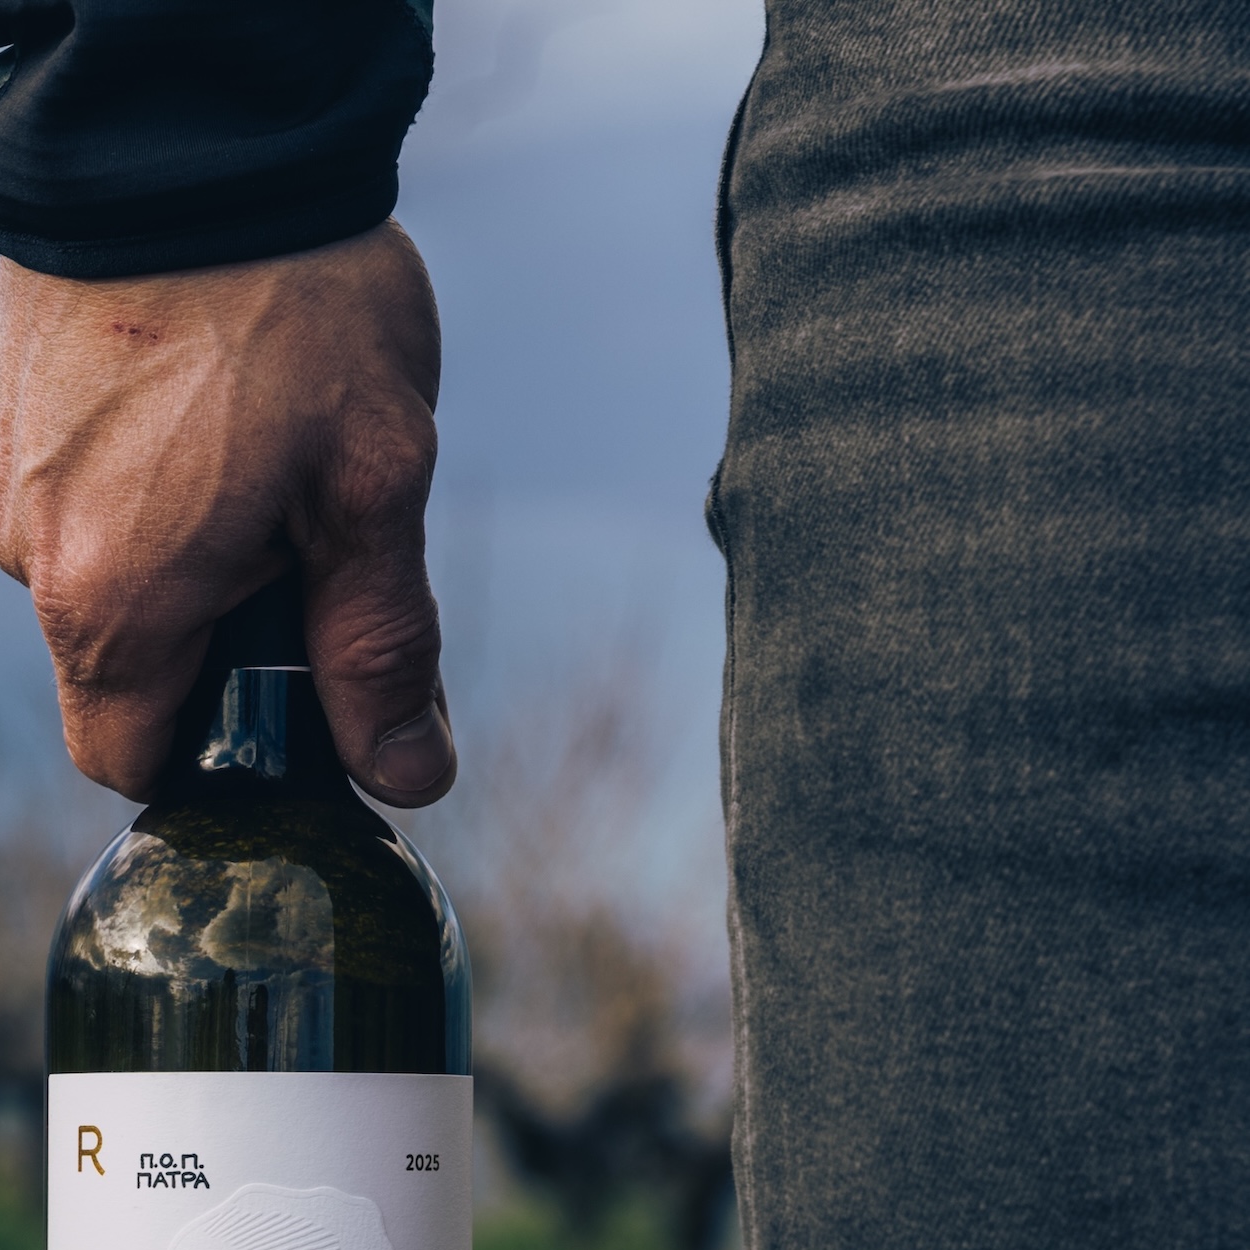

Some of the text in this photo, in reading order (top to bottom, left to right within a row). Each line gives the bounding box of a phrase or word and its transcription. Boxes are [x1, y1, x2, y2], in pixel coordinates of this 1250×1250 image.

[77, 1125, 106, 1176] R
[405, 1154, 440, 1172] 2025
[136, 1170, 211, 1190] ΠΑΤΡΑ
